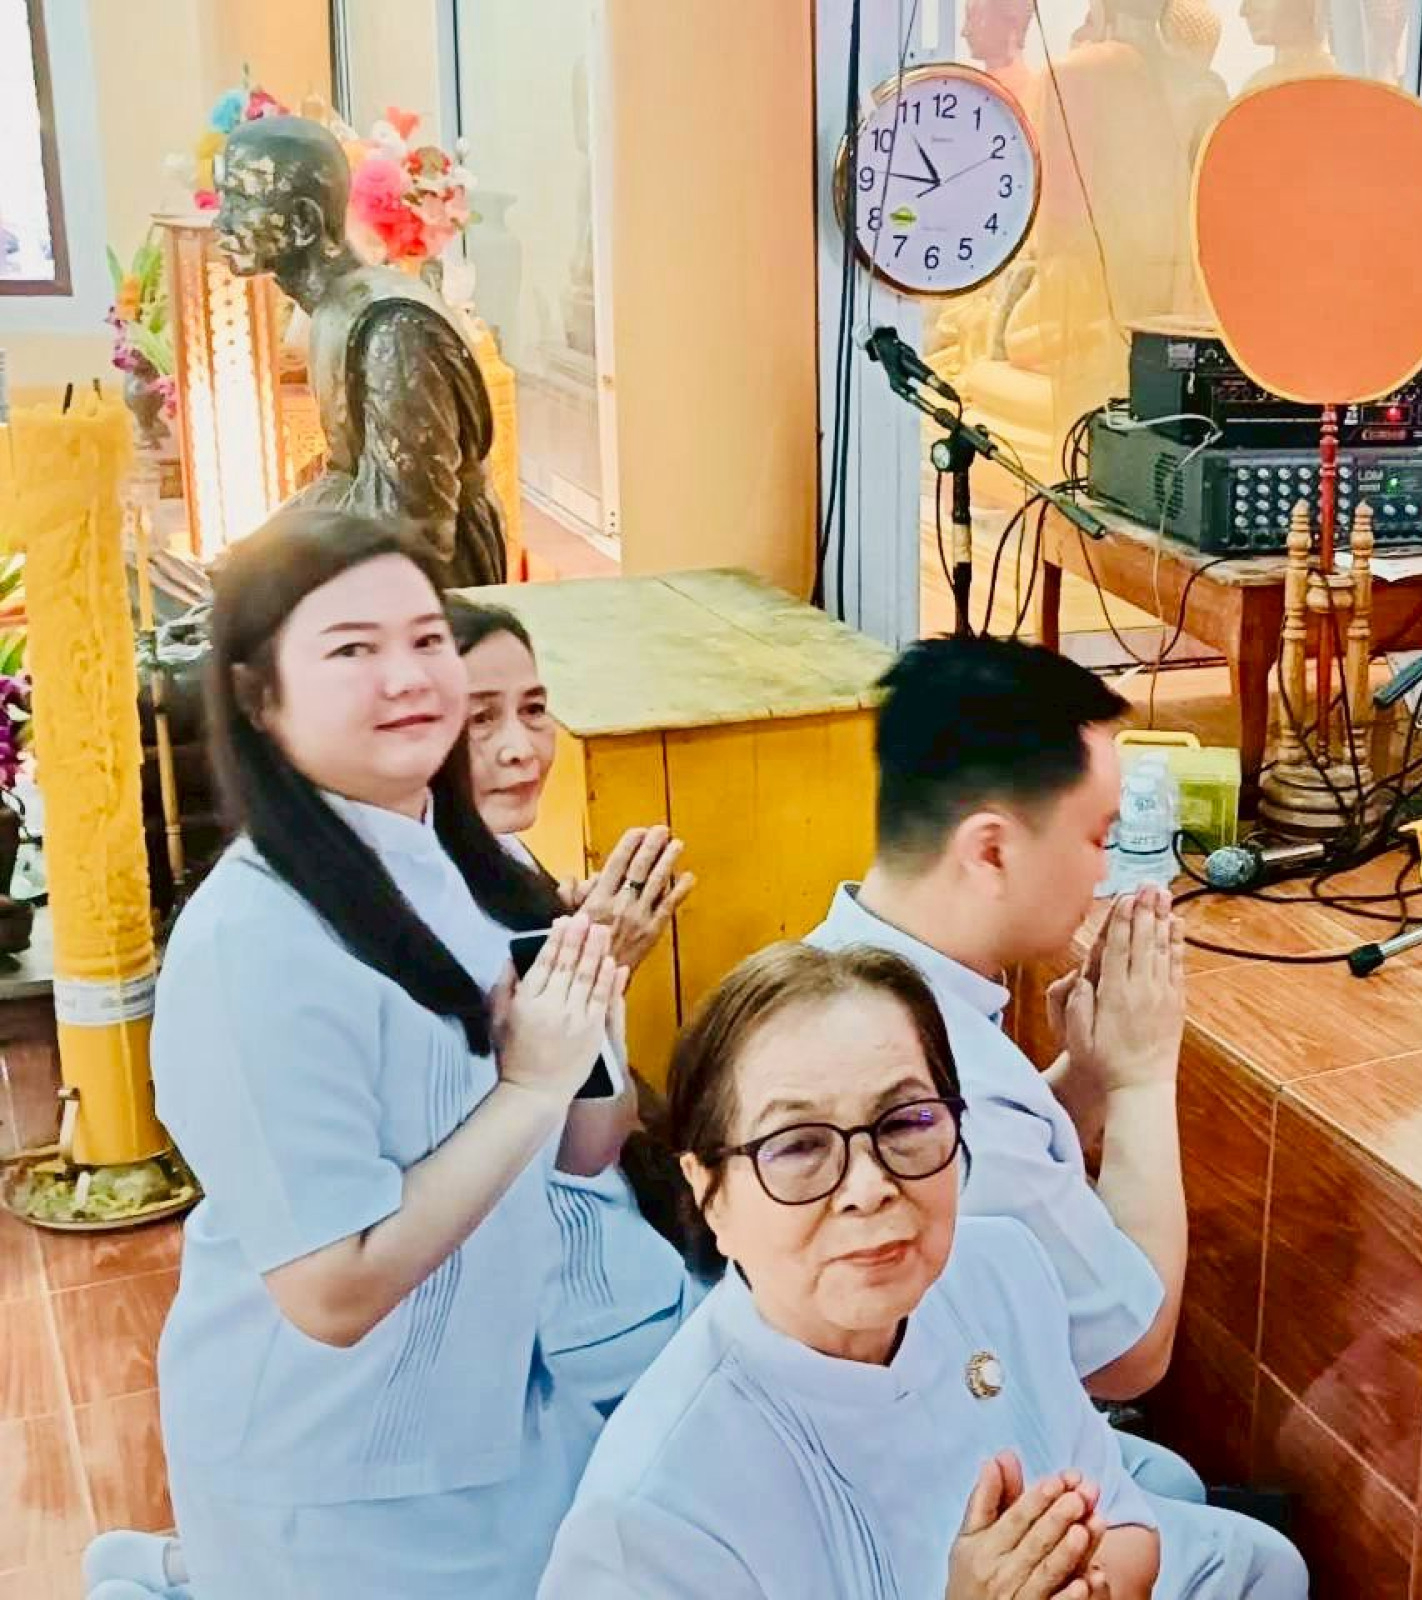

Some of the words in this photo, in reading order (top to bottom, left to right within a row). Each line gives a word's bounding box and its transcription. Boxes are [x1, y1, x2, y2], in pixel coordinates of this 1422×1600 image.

[898, 100, 921, 125] 11
[932, 93, 958, 119] 12
[972, 107, 982, 131] 1
[871, 128, 894, 153] 10
[989, 135, 1006, 159] 2
[858, 166, 875, 192] 9
[998, 174, 1013, 198] 3
[867, 207, 882, 231] 8
[984, 212, 999, 235] 4
[892, 235, 908, 258] 7
[924, 245, 940, 269] 6
[957, 238, 973, 261] 5
